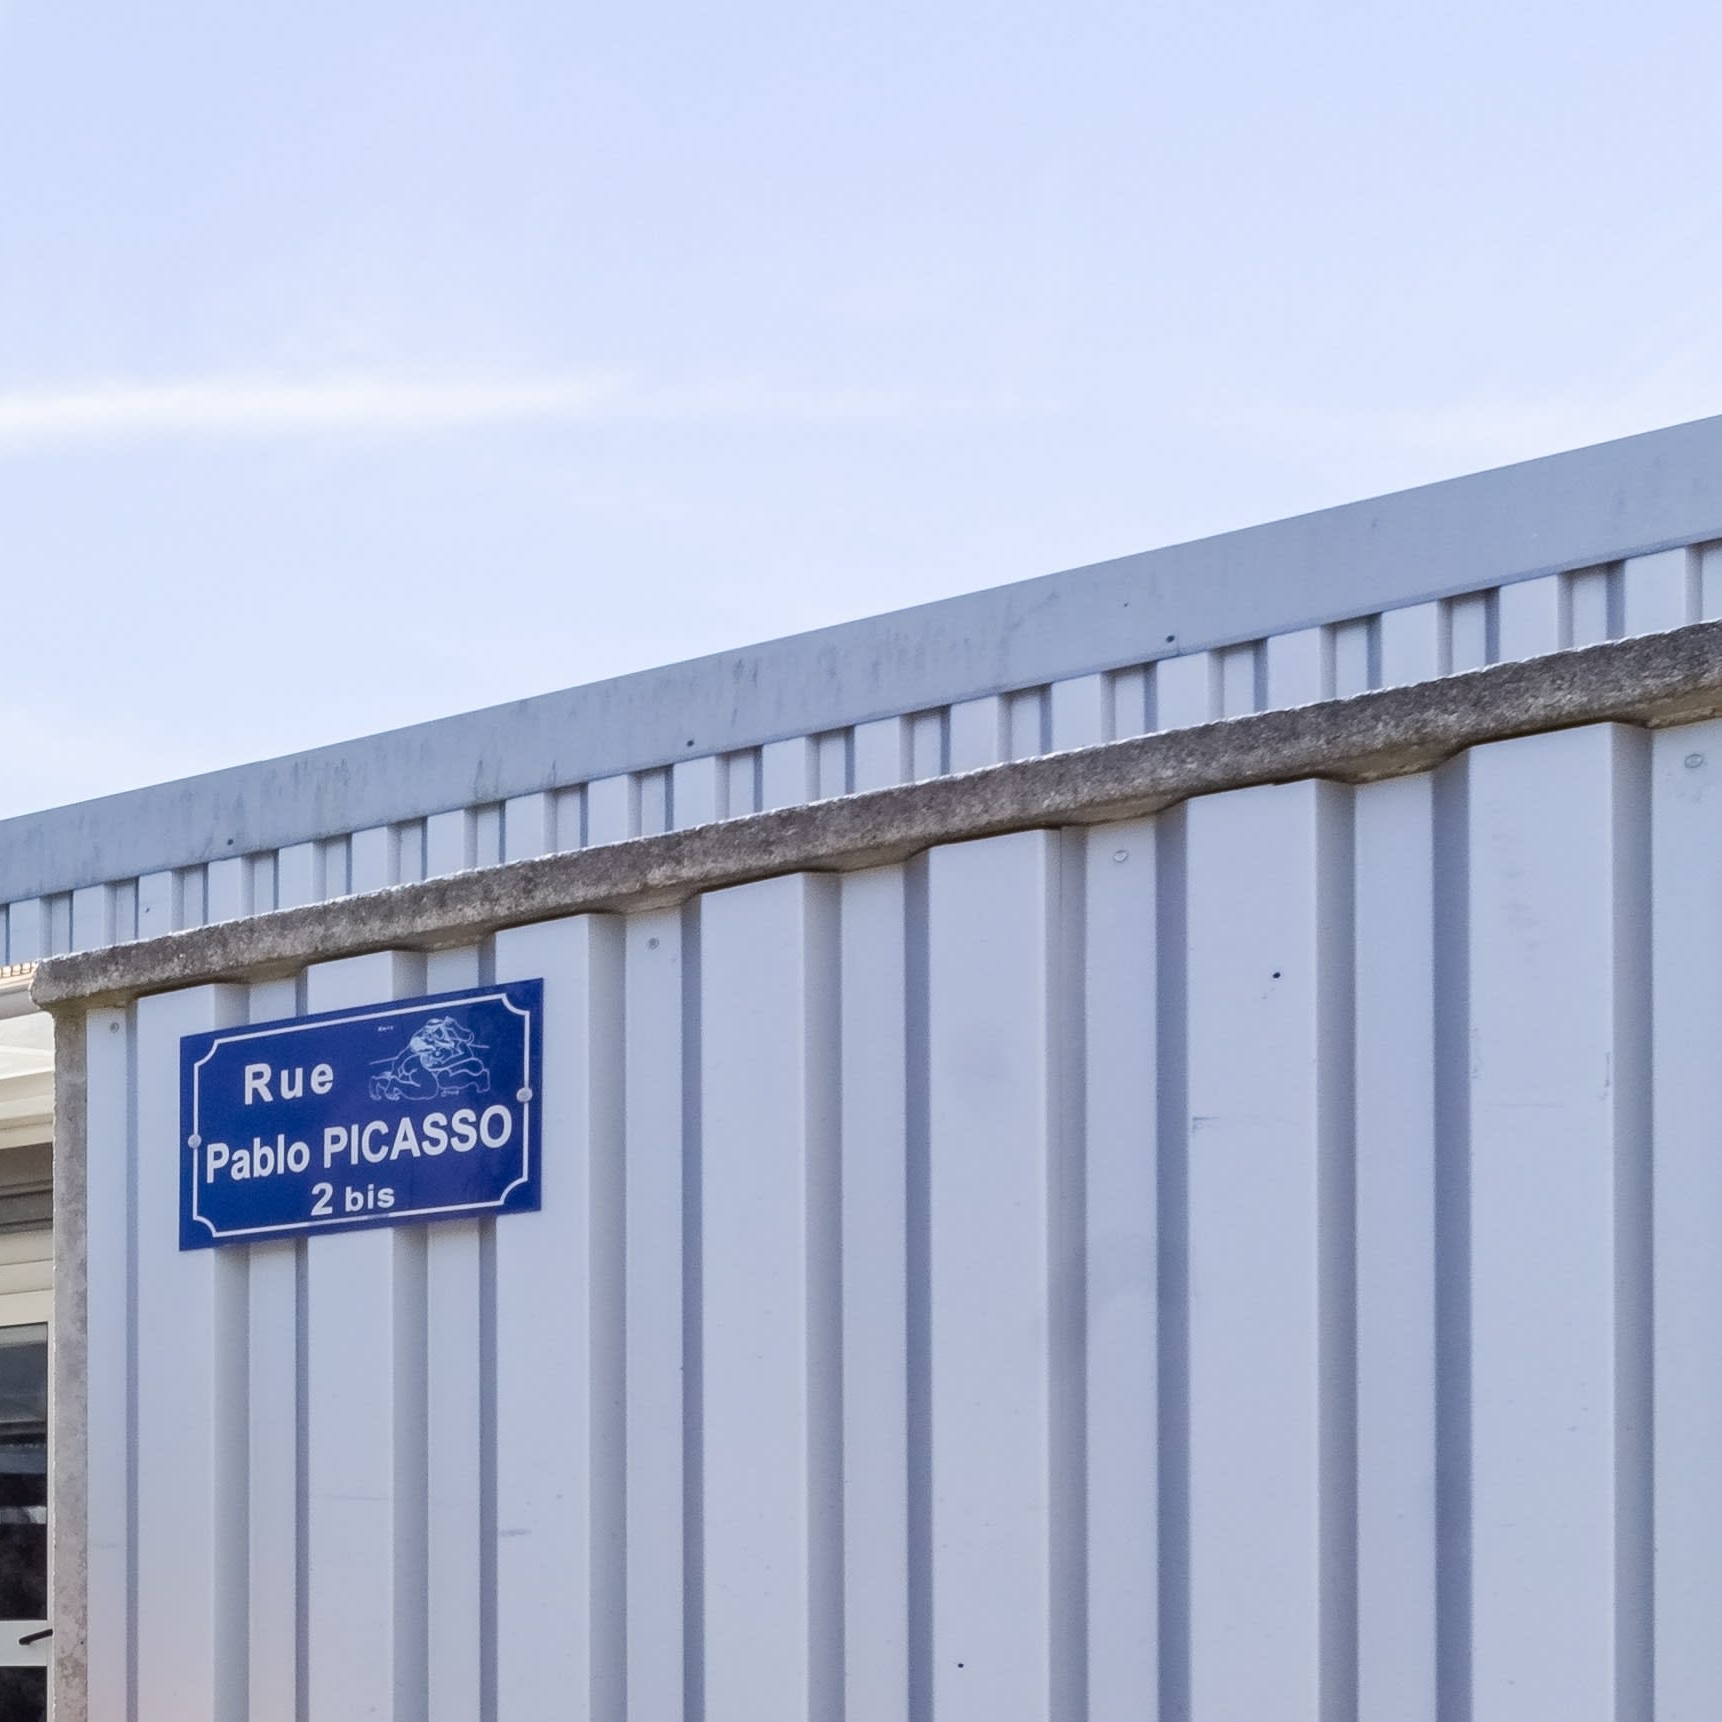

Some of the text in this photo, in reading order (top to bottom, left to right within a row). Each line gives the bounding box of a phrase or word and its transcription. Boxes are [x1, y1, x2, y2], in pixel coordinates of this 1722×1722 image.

[244, 1062, 334, 1105] Rue
[206, 1104, 513, 1184] Pablo PICASSO
[310, 1182, 395, 1216] 2 bis
